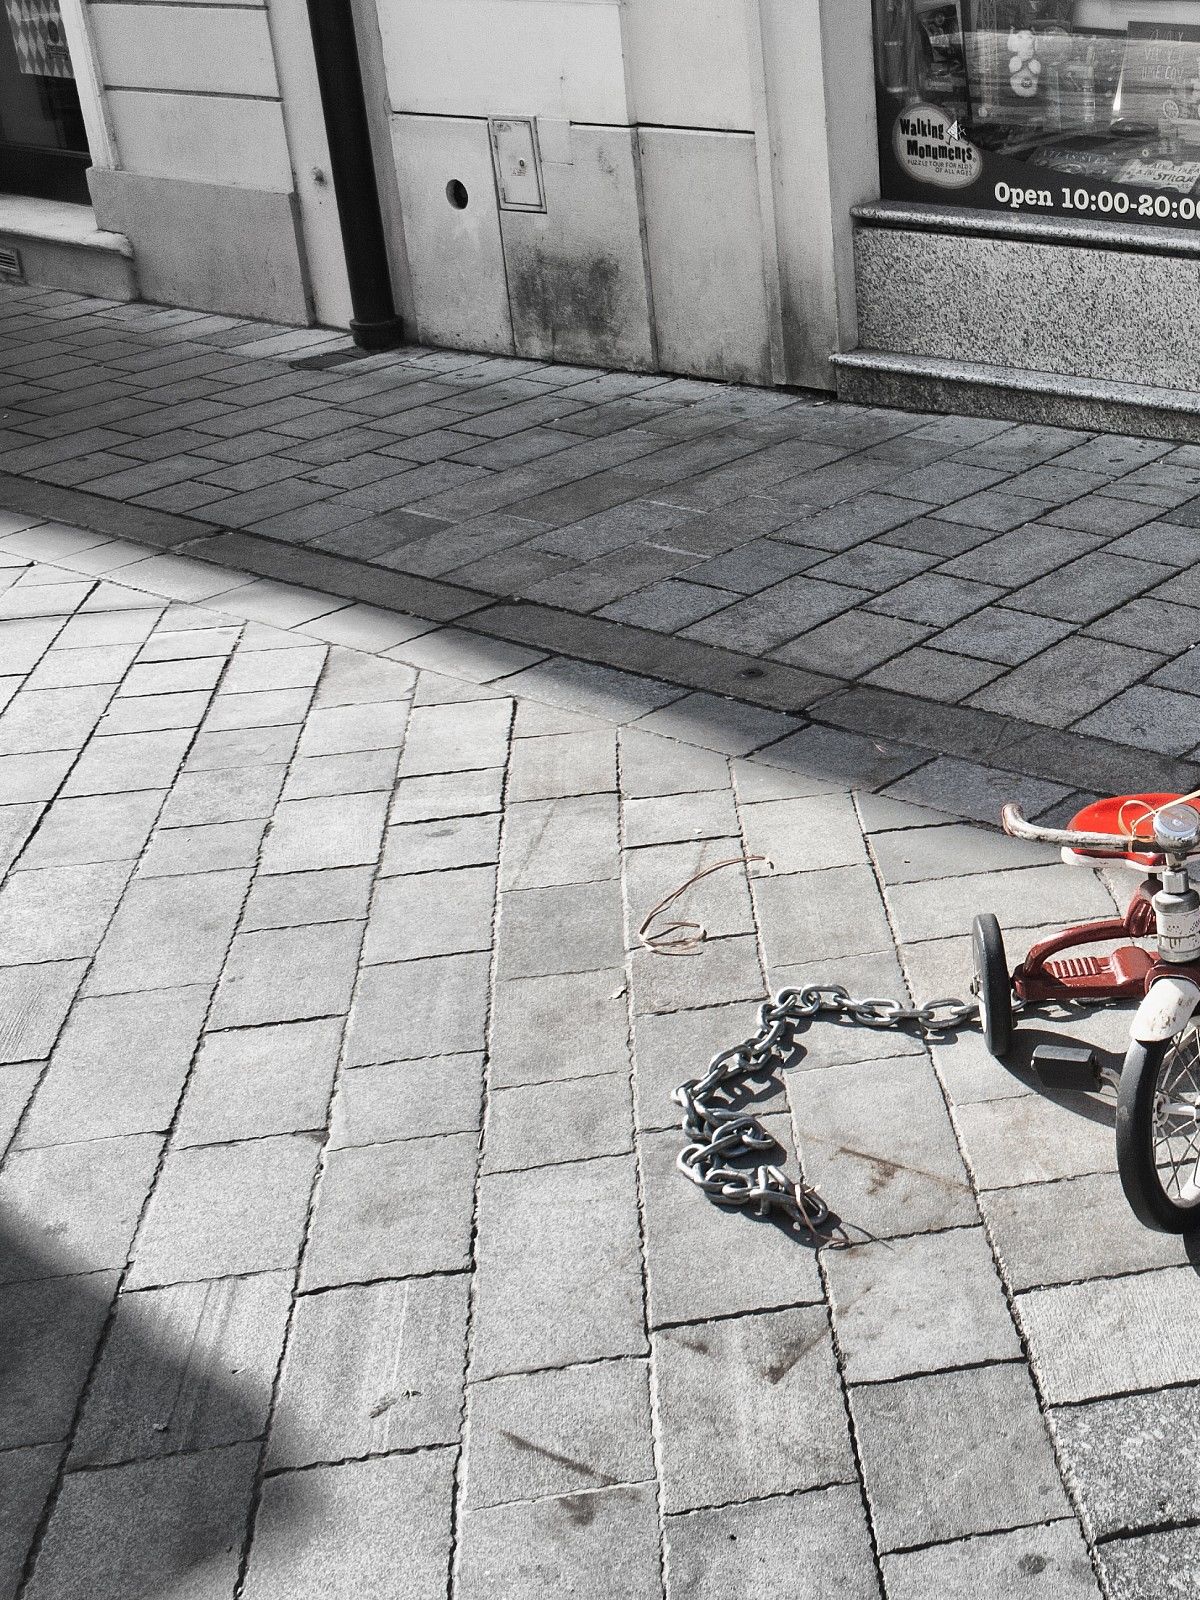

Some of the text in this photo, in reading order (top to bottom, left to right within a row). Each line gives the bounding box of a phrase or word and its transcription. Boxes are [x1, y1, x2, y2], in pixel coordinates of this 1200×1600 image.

[900, 118, 944, 140] Walking
[906, 140, 973, 163] Monuments
[994, 182, 1054, 208] Open
